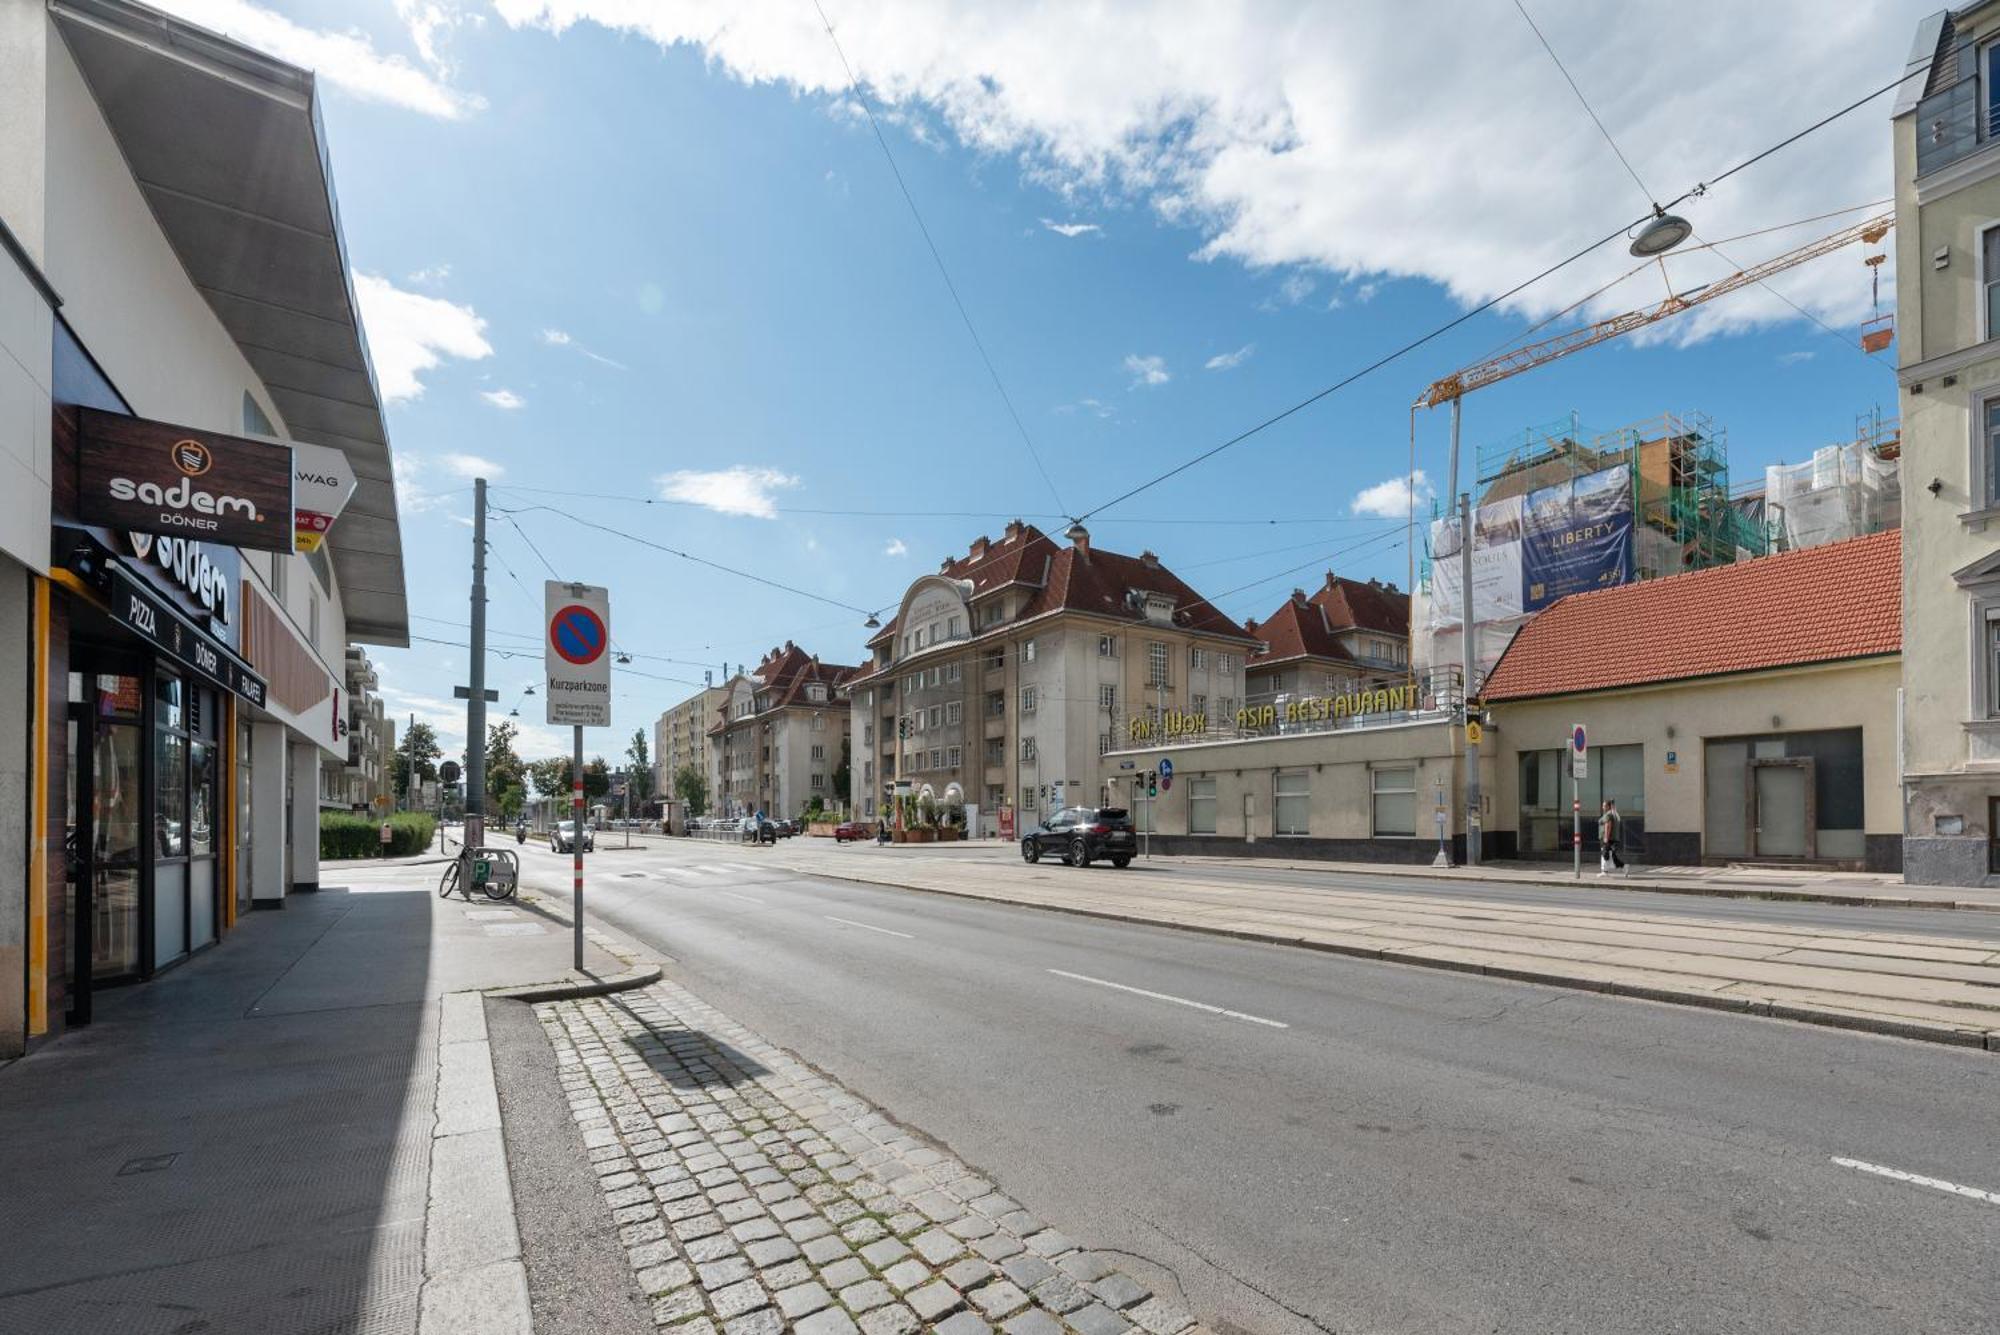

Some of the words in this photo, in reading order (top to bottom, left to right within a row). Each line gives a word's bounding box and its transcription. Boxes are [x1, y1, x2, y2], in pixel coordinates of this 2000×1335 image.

[295, 472, 338, 487] WAG
[160, 513, 218, 531] DÖNER
[1552, 521, 1614, 549] LIBERTY
[129, 595, 157, 637] PIZZA
[195, 641, 217, 675] DÖNER
[550, 678, 608, 693] Kurzparkzone
[1237, 705, 1275, 728] ASIA
[1286, 685, 1417, 722] RESTAURANT
